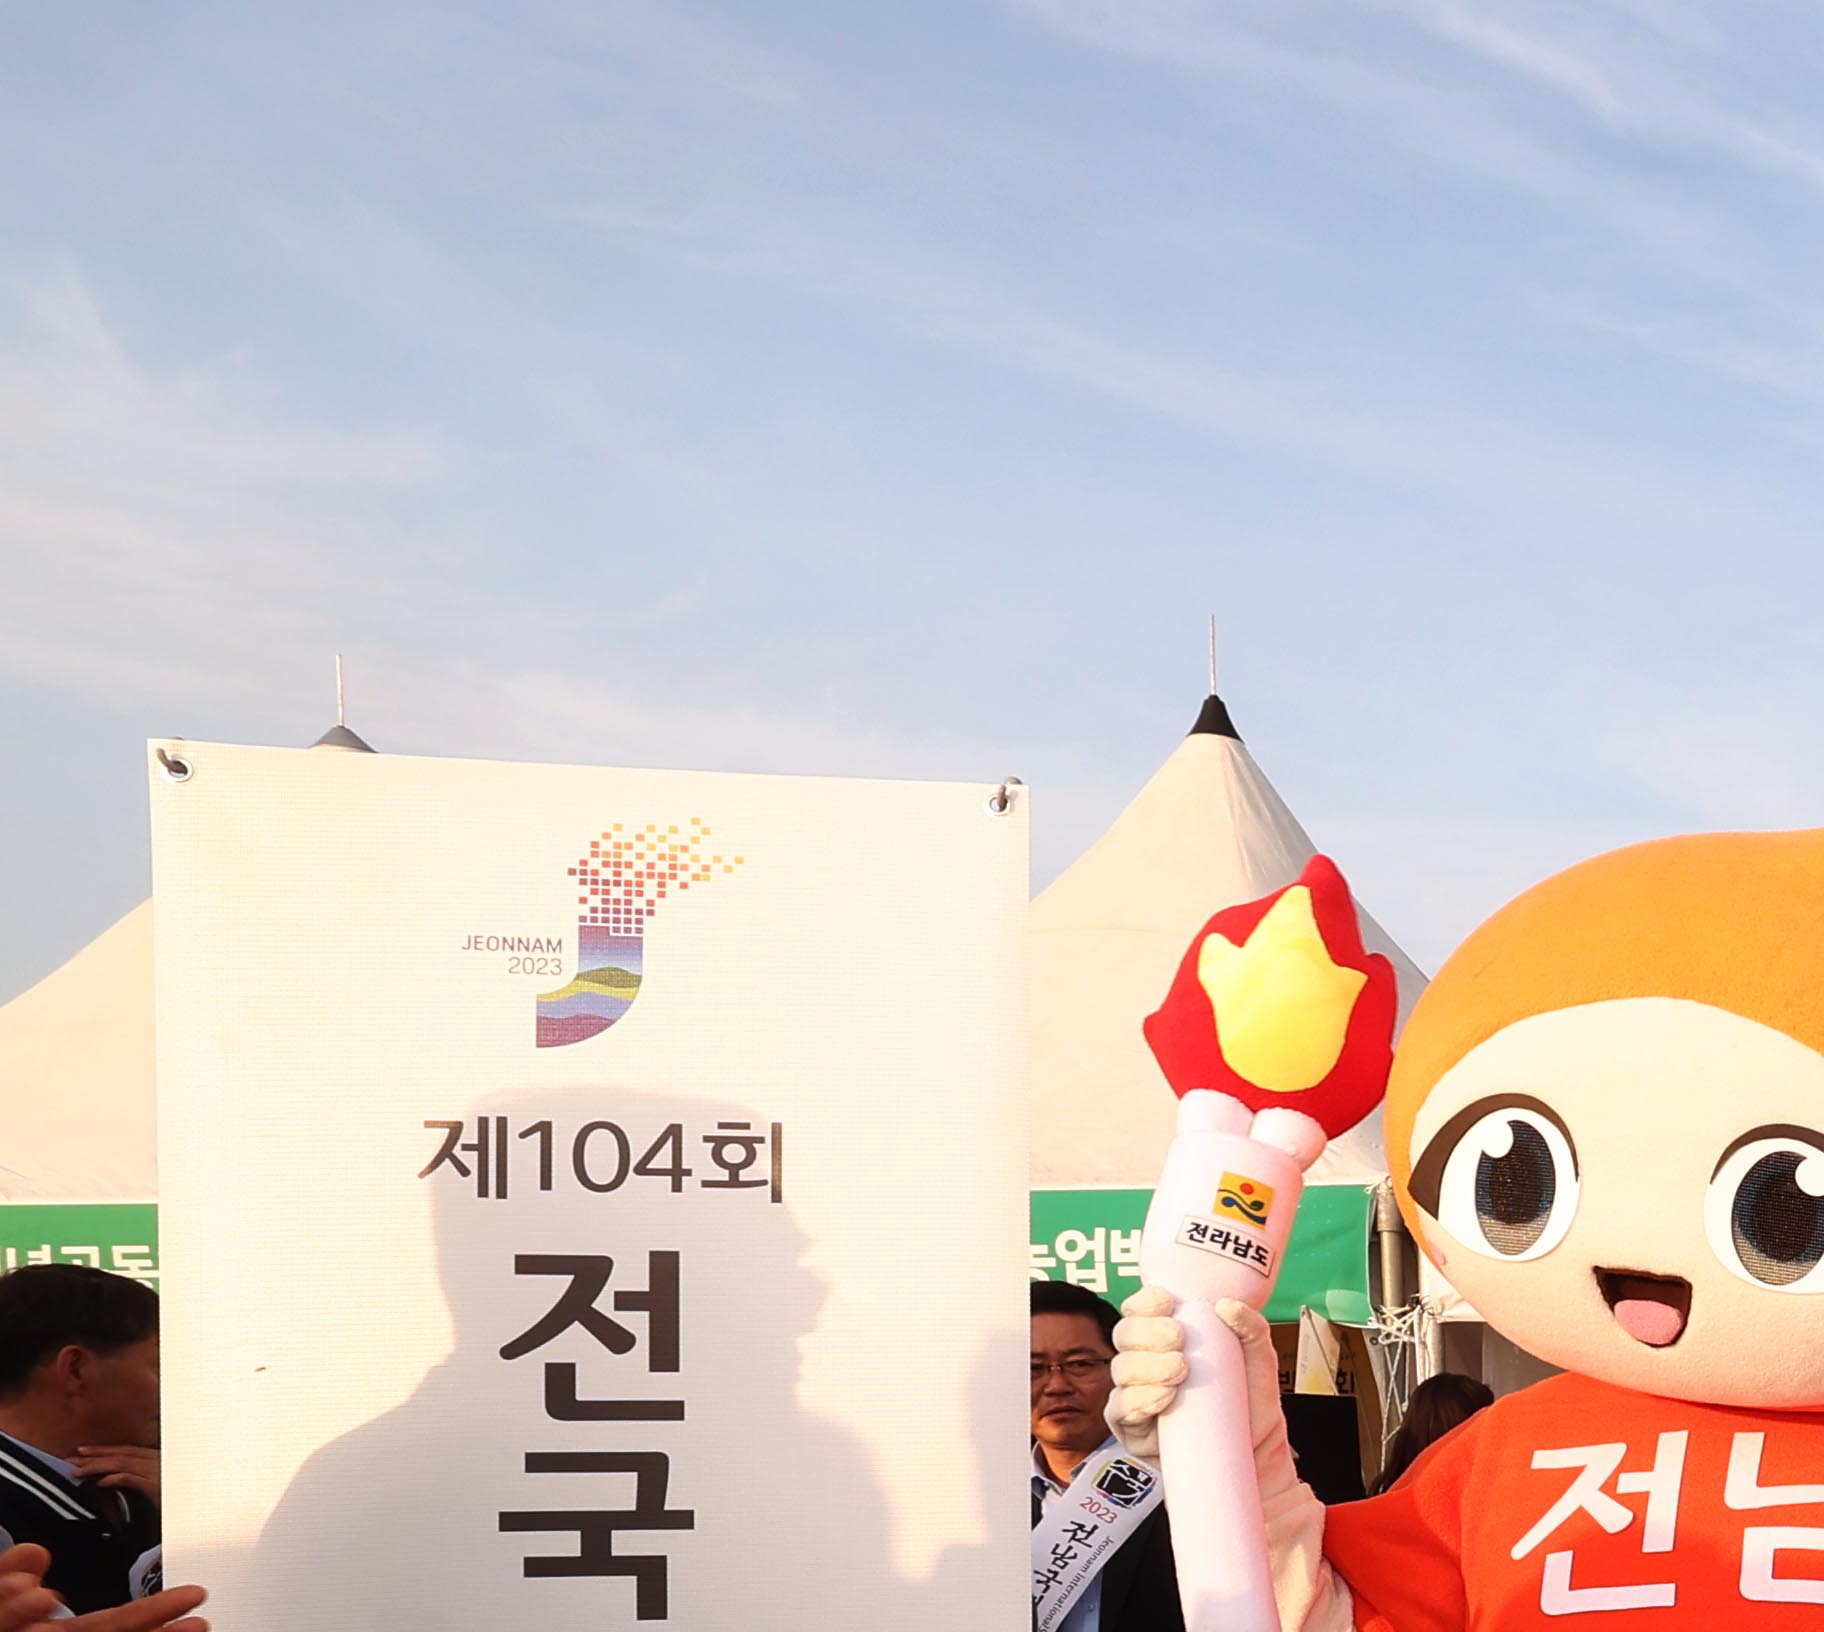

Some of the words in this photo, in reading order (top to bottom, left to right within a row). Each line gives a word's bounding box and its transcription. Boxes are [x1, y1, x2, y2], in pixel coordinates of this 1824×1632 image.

[461, 934, 563, 955] JEONNAM
[507, 956, 563, 977] 2023
[417, 1115, 783, 1204] 제104회
[1187, 1221, 1269, 1267] 전라남도
[1079, 1496, 1119, 1525] 2023
[1082, 1535, 1115, 1573] Jeonnam
